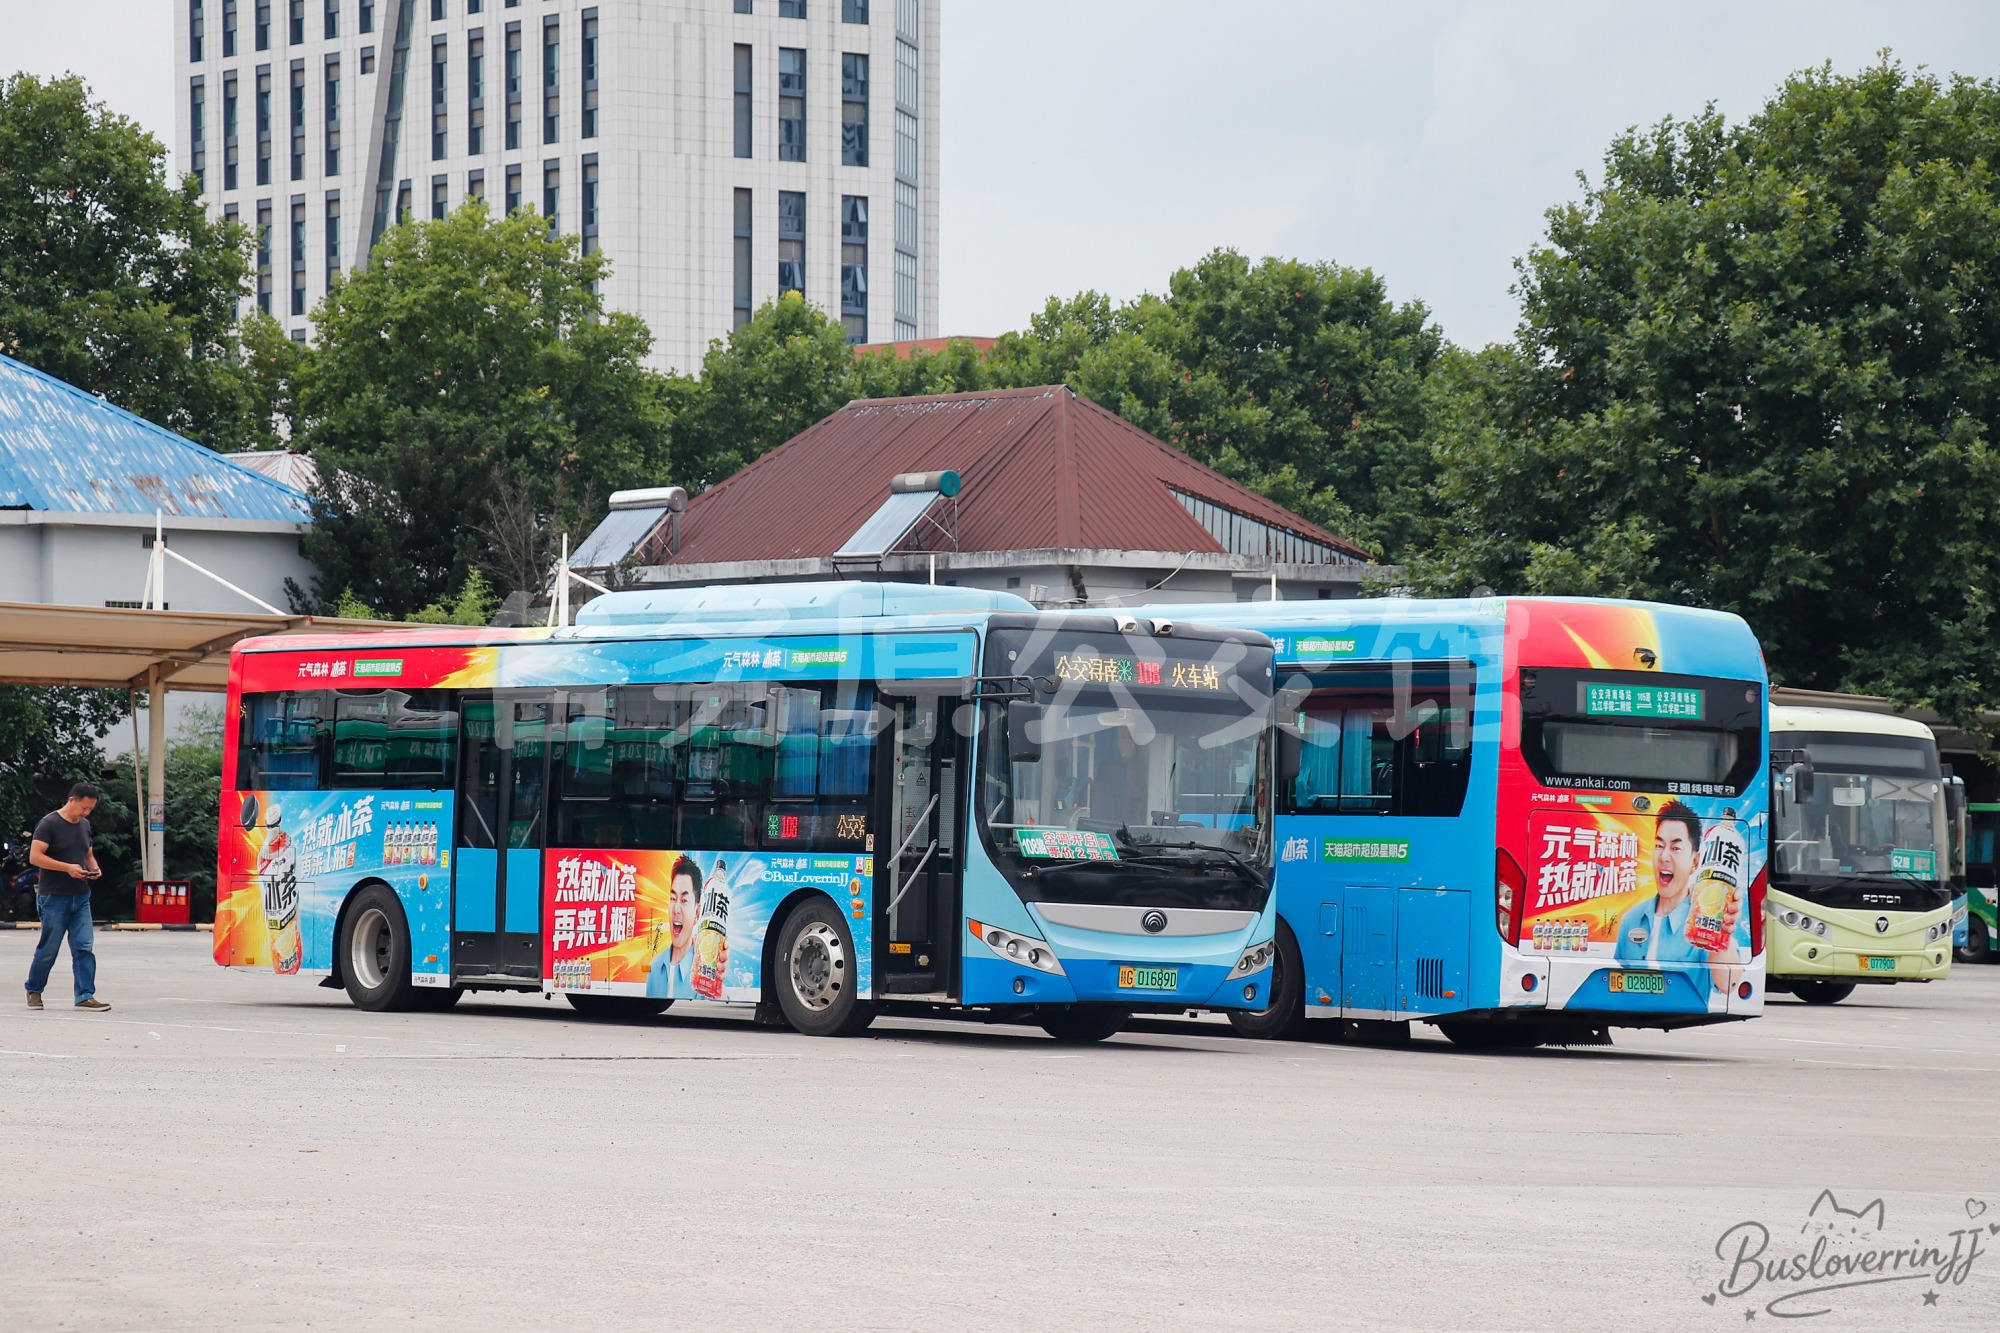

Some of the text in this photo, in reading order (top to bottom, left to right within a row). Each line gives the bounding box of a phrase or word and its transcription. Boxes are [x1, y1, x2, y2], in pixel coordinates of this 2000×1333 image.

[298, 662, 328, 678] 元气森林
[723, 650, 760, 668] 元气森林
[1171, 662, 1219, 690] 火车站
[1545, 776, 1631, 790] www.ankai.com
[302, 794, 375, 856] 热就冰茶
[1042, 831, 1097, 847] 空调开启
[1281, 836, 1409, 862] 冰茶 天猫超市超级星期5
[1540, 825, 1638, 859] 元气森林
[301, 844, 349, 880] 再来1瓶
[1046, 846, 1102, 861] 票价2元
[554, 853, 637, 902] 热就冰茶
[1535, 858, 1638, 908] 热就冰茶
[1862, 894, 1902, 904] FOTON
[553, 904, 628, 952] 再来1瓶
